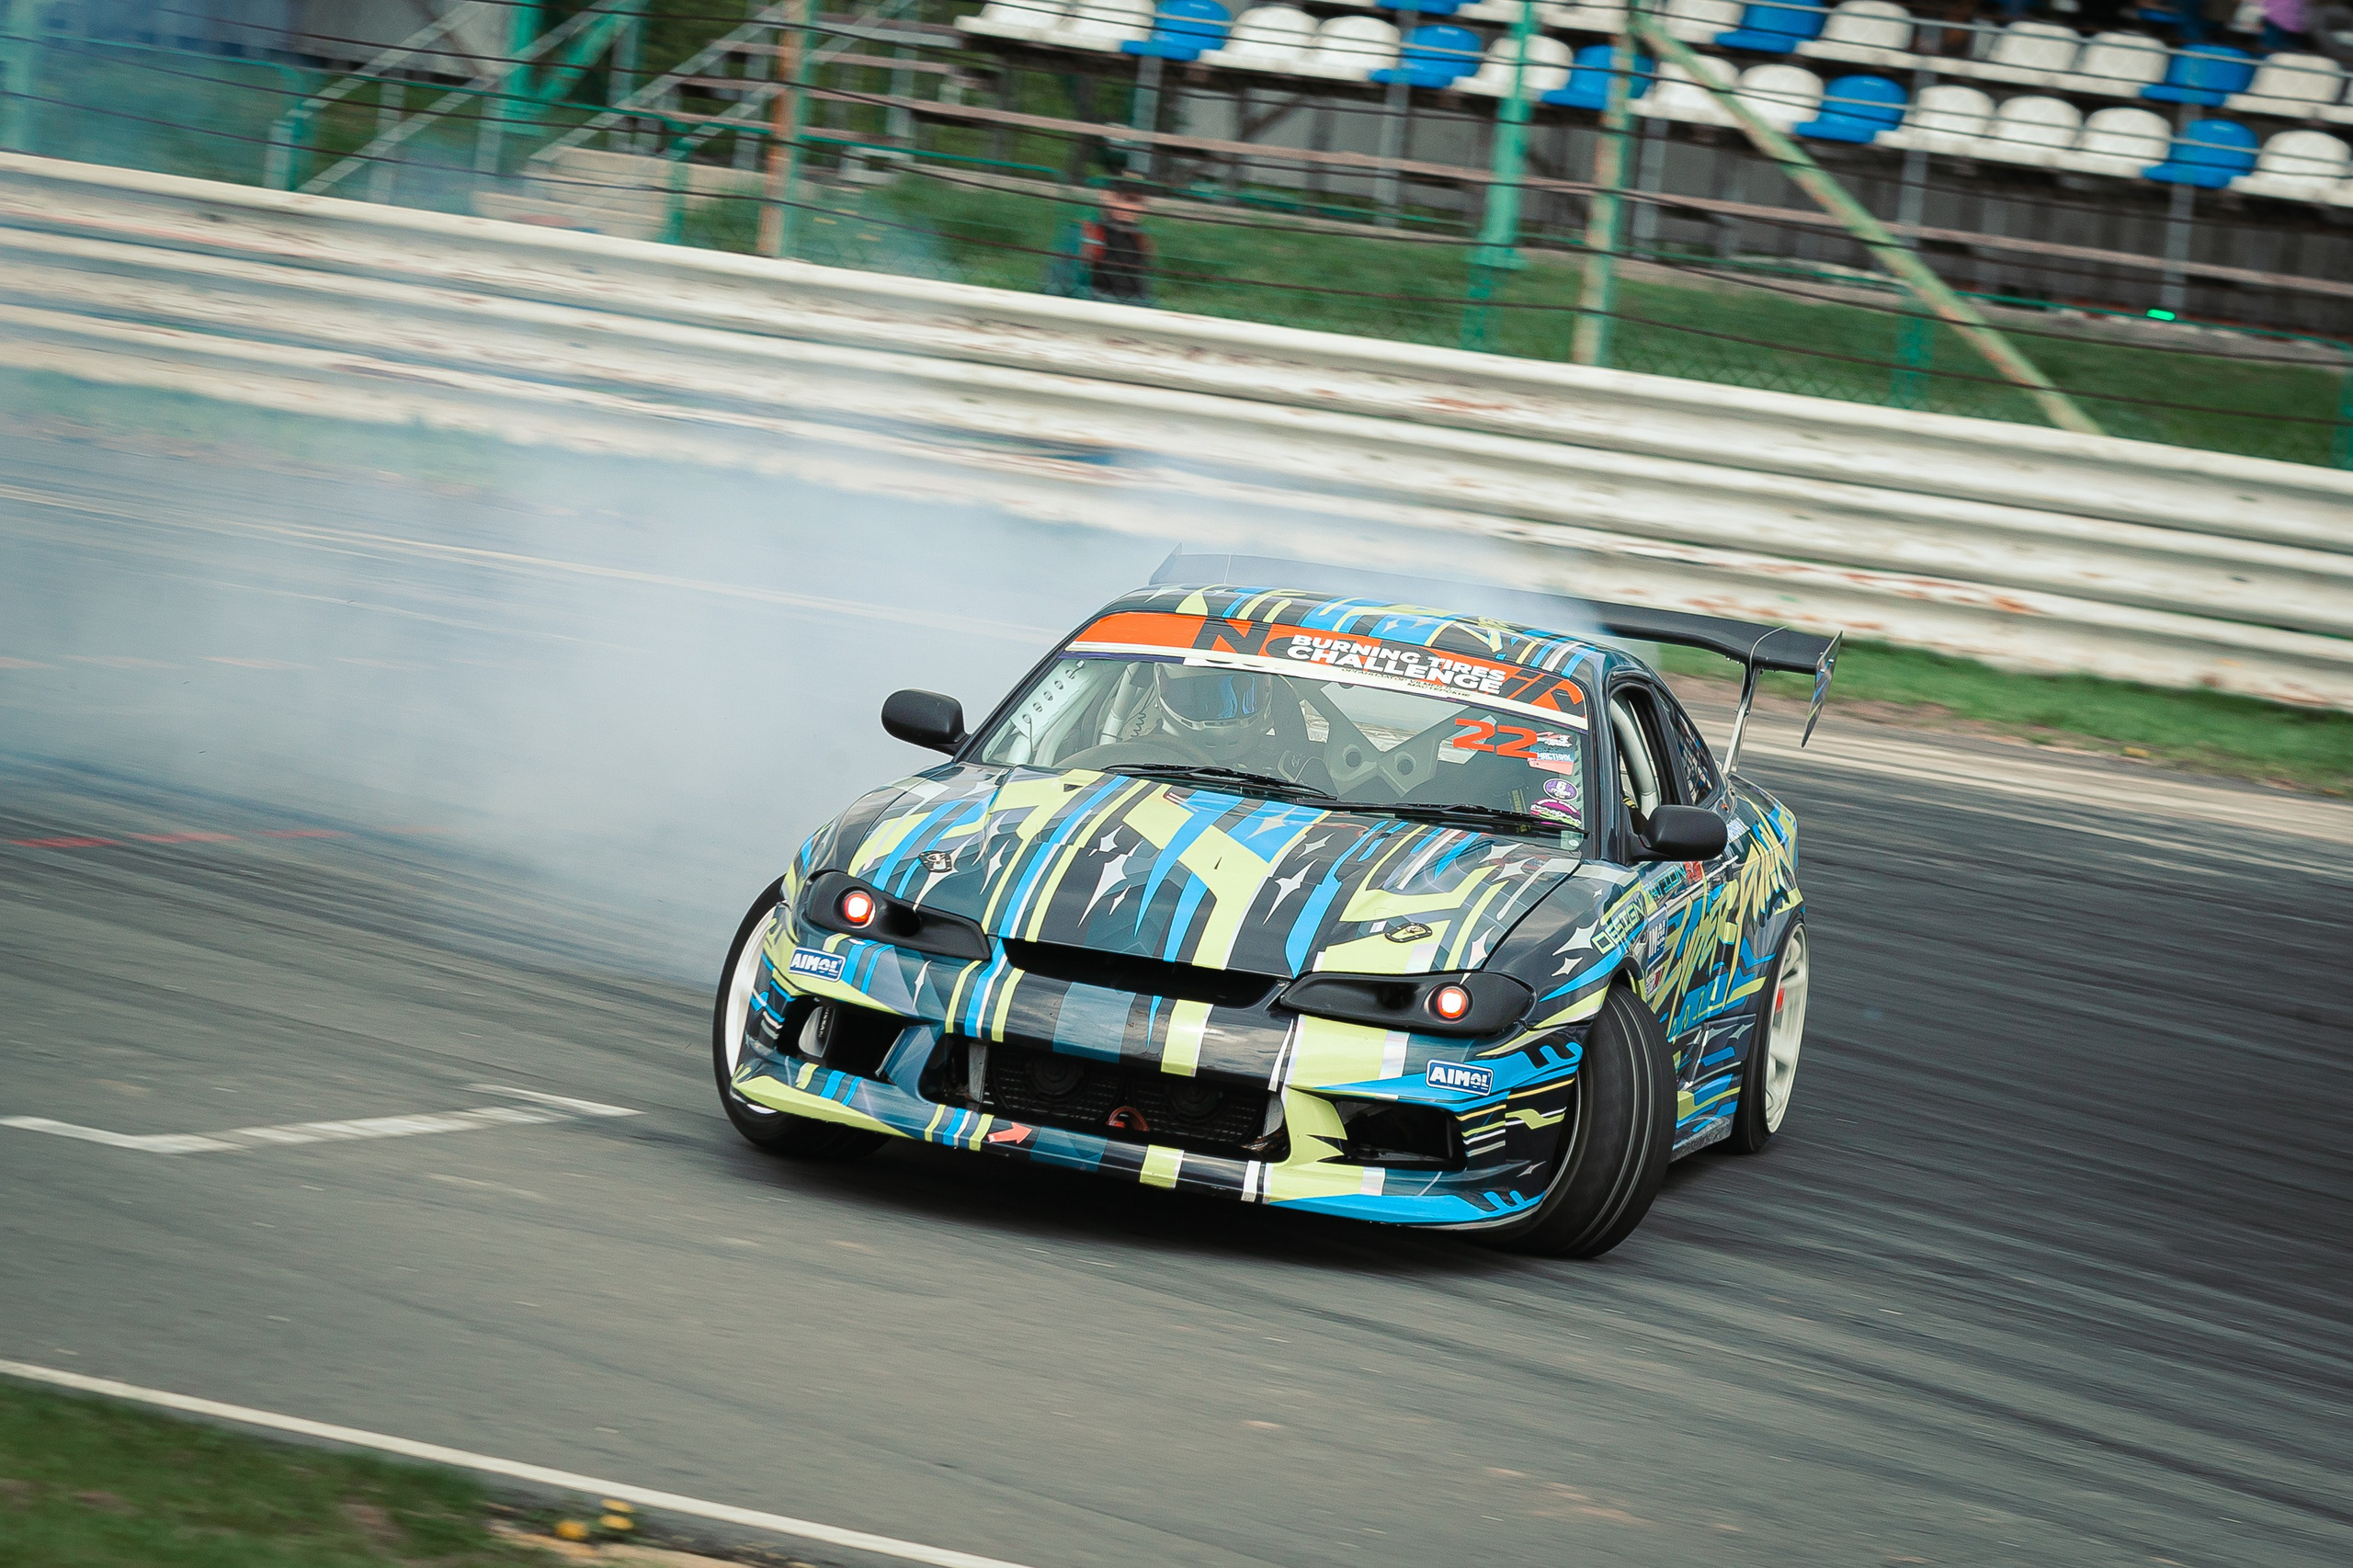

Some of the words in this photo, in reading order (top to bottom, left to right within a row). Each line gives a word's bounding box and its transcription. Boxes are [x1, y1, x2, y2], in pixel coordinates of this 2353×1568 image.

[1286, 645, 1504, 694] CHALLENGE
[1290, 634, 1421, 664] BURNING
[1427, 656, 1506, 681] TIRES
[1452, 718, 1538, 759] 22
[790, 953, 839, 974] AIMOL
[1429, 1066, 1489, 1090] AIMOL
